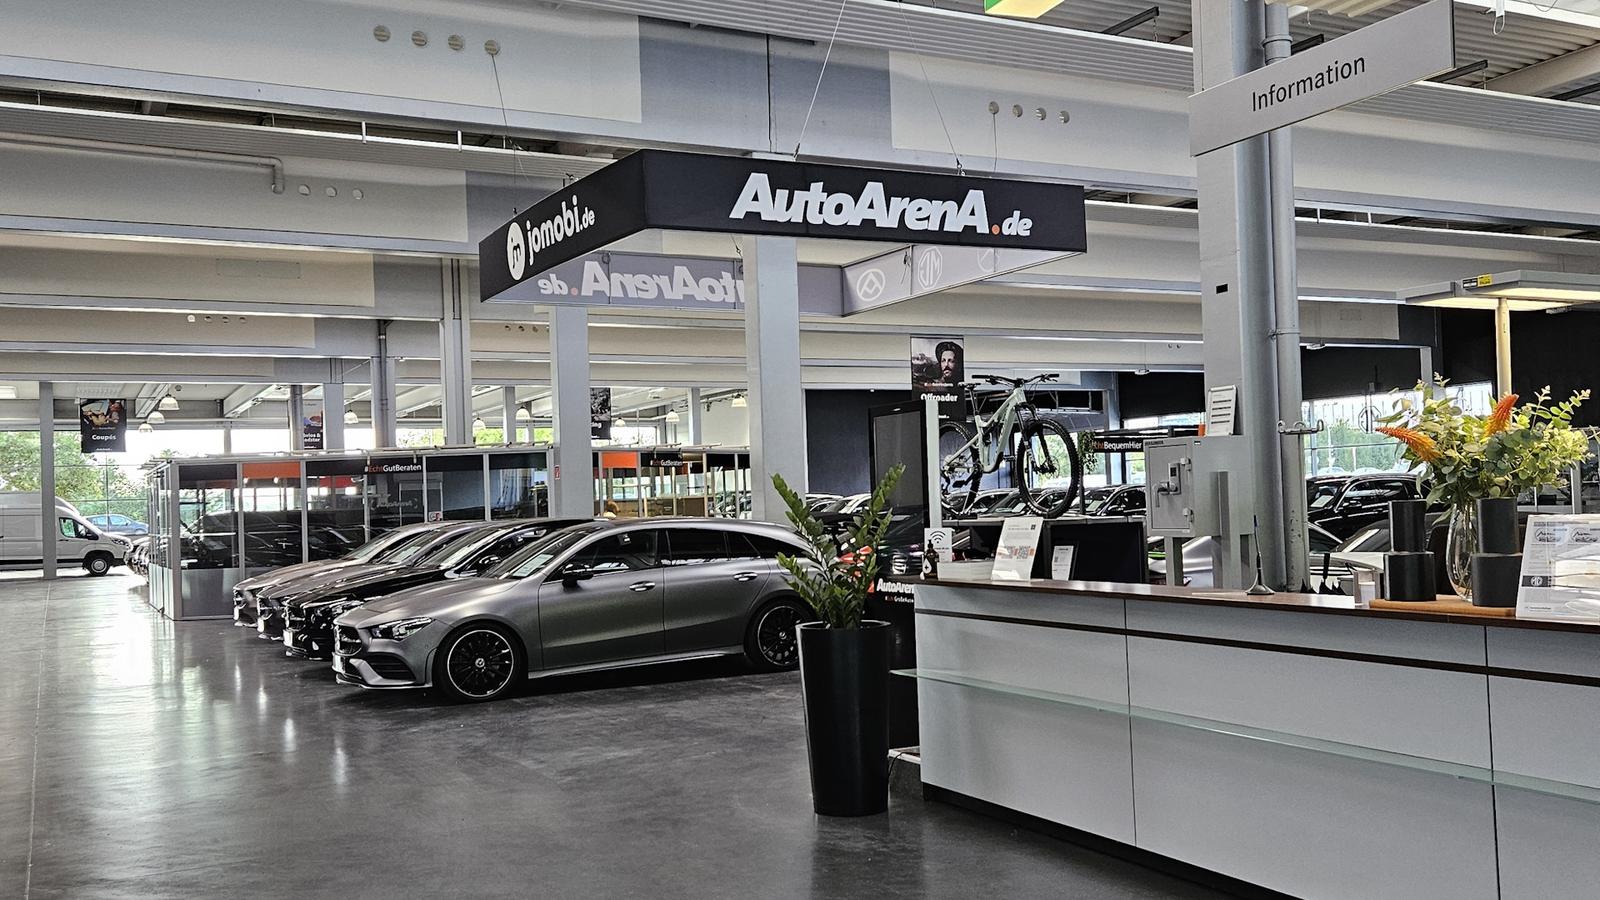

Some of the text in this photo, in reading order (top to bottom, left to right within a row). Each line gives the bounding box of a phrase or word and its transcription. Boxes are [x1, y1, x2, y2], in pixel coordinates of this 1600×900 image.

[1252, 57, 1365, 112] Information
[525, 194, 596, 267] jomobi.de
[730, 172, 1033, 237] AutoArenA.de
[920, 393, 959, 401] Offroader
[91, 434, 117, 442] Coupés
